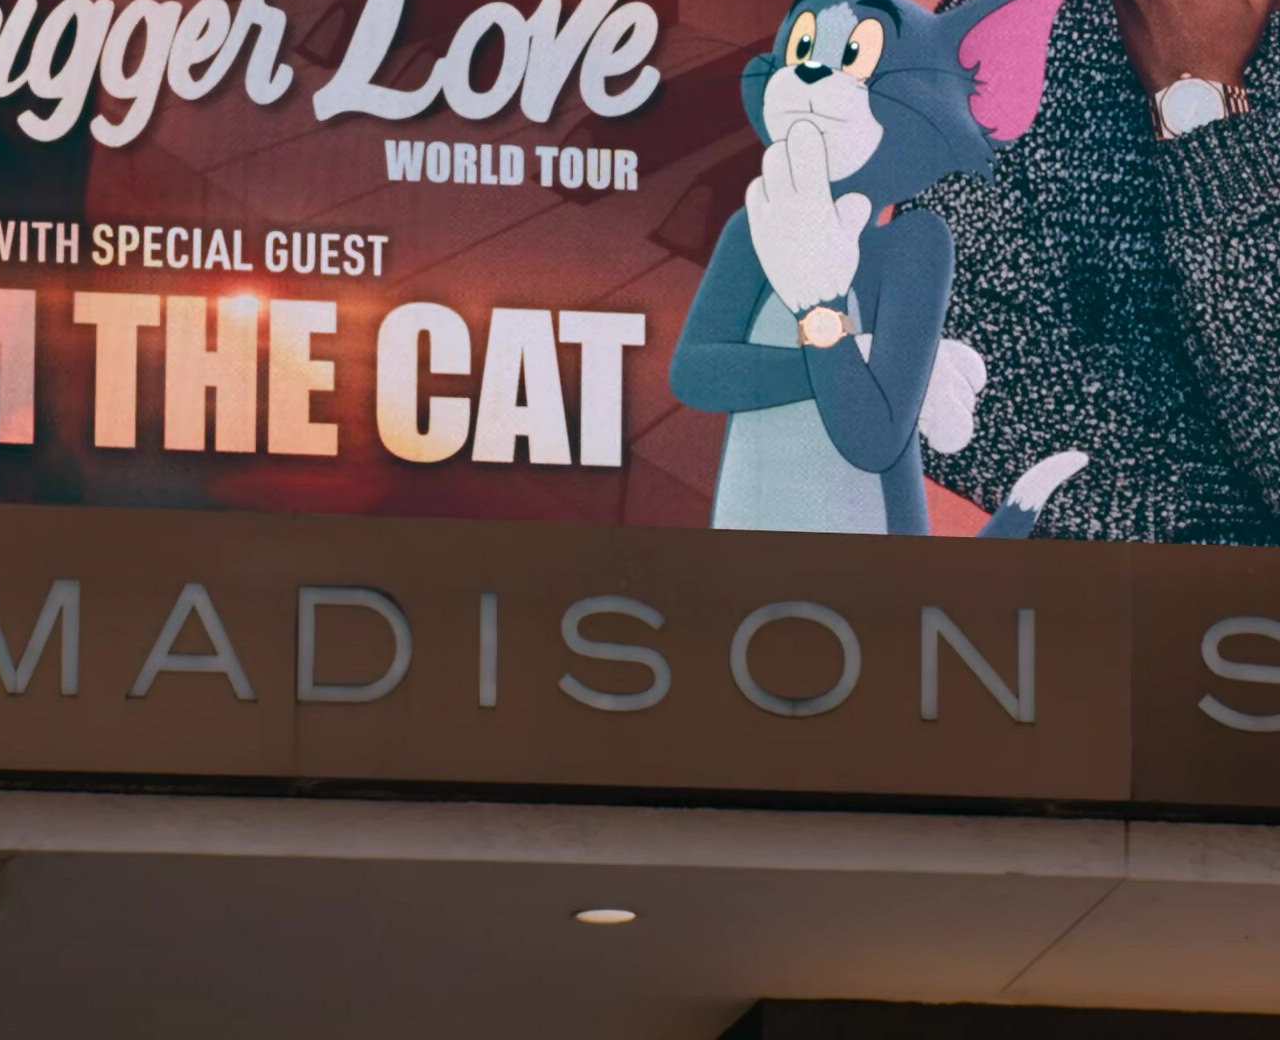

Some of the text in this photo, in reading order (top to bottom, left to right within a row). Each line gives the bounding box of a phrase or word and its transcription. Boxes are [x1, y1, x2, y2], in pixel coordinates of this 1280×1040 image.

[384, 139, 639, 191] WORLD TOUR
[91, 223, 253, 272] SPECIAL
[265, 229, 389, 277] GUEST
[73, 291, 337, 456] THE
[376, 301, 646, 467] CAT
